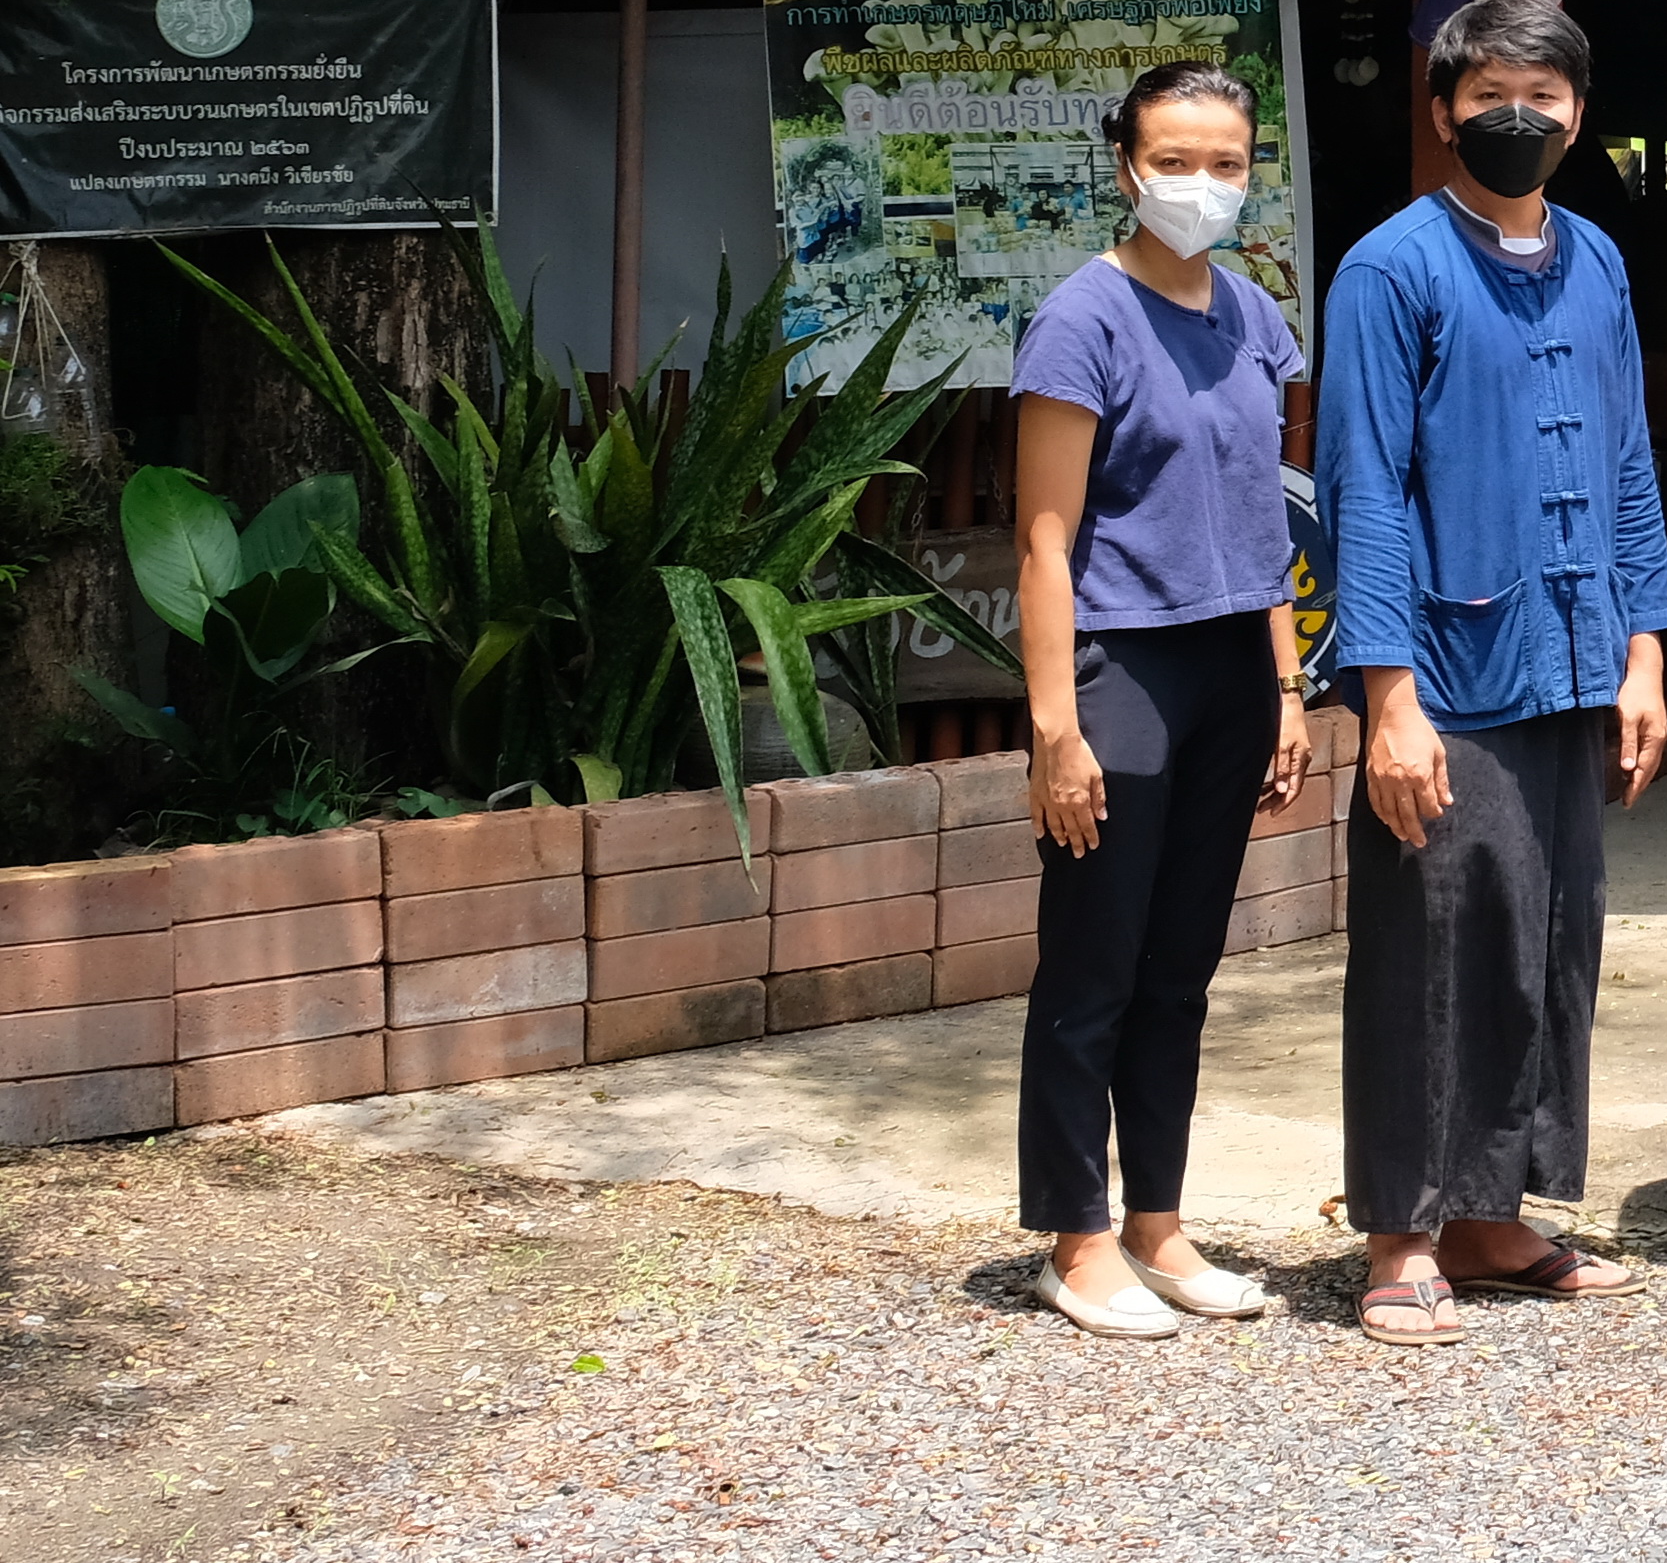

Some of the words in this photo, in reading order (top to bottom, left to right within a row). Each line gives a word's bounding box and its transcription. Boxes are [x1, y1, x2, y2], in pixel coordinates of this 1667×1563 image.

[61, 52, 362, 84] โครงการพัฒนาเกษตรกรรมยั่งยืน
[118, 136, 244, 160] ปีงบประมาณ
[250, 139, 311, 156] ๒๕๖๓
[69, 173, 207, 191] แปลงเกษตรกรรม
